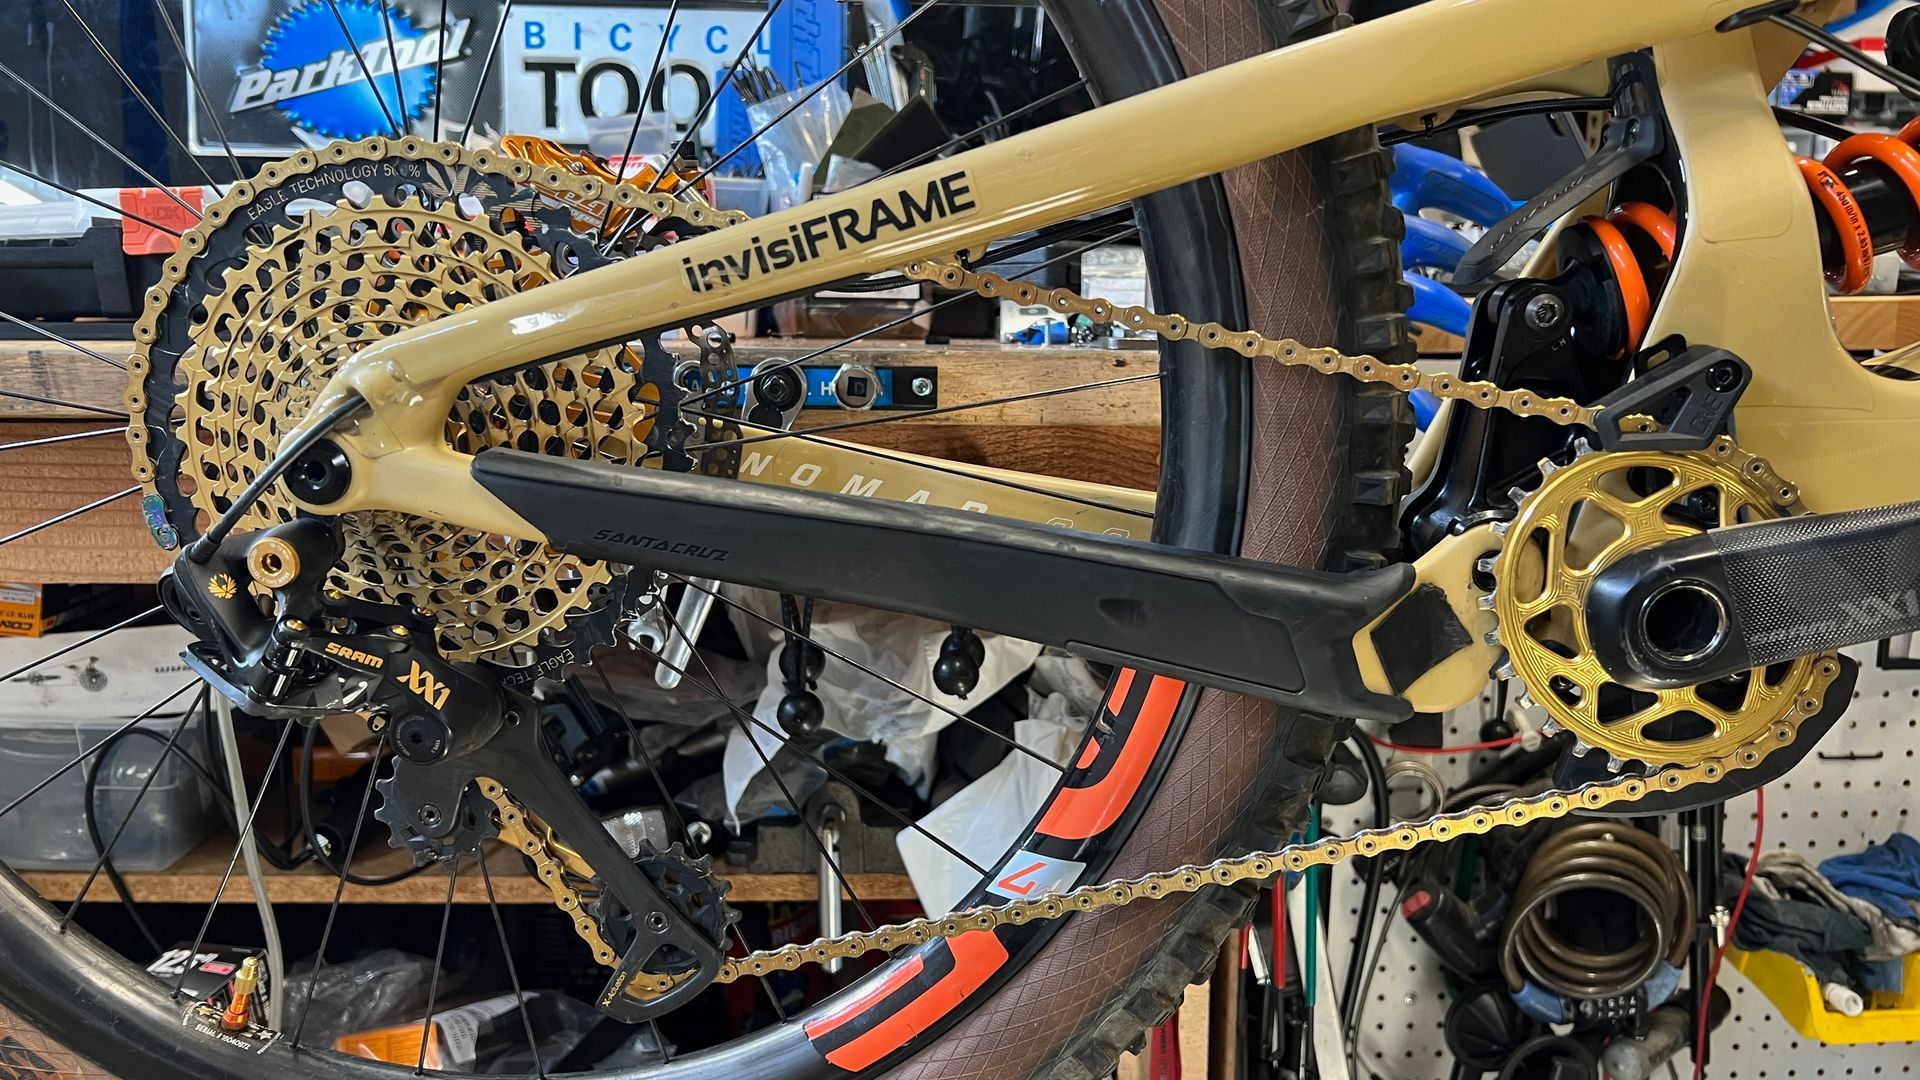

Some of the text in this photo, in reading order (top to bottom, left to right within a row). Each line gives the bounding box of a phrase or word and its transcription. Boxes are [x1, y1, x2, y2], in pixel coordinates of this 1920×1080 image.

[230, 18, 471, 113] ParkTool
[247, 191, 289, 221] EAGLE
[289, 164, 379, 194] TECHNOLOGY
[682, 170, 976, 293] invisiFRAME
[325, 642, 384, 669] SRAM
[396, 660, 451, 711] XX1
